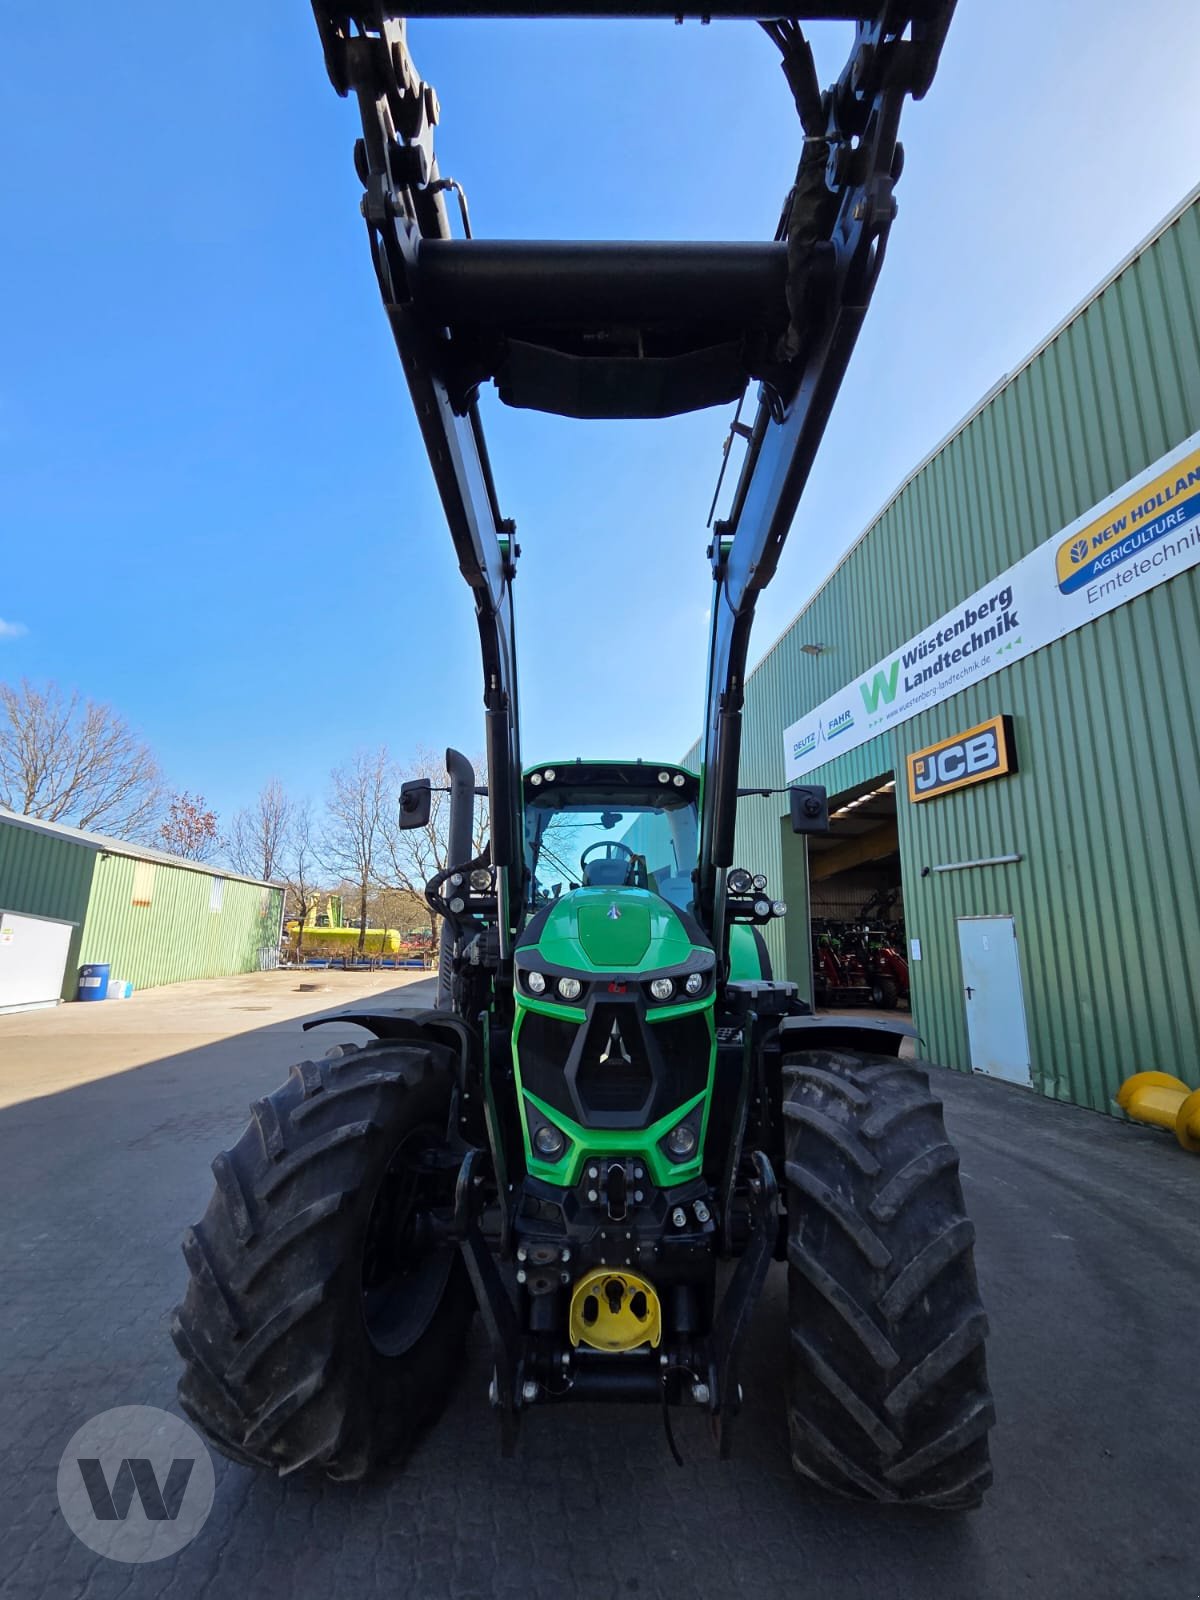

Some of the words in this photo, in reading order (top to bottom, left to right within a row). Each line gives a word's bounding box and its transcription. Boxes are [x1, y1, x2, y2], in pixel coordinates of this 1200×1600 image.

[1093, 516, 1127, 549] NEW
[1093, 507, 1187, 574] AGRICULTURE
[903, 585, 1014, 669] Wüstenberg
[904, 611, 1020, 693] Landtechnik
[793, 732, 816, 752] DEUTZ
[828, 710, 851, 730] FAHR
[916, 733, 996, 790] JCB
